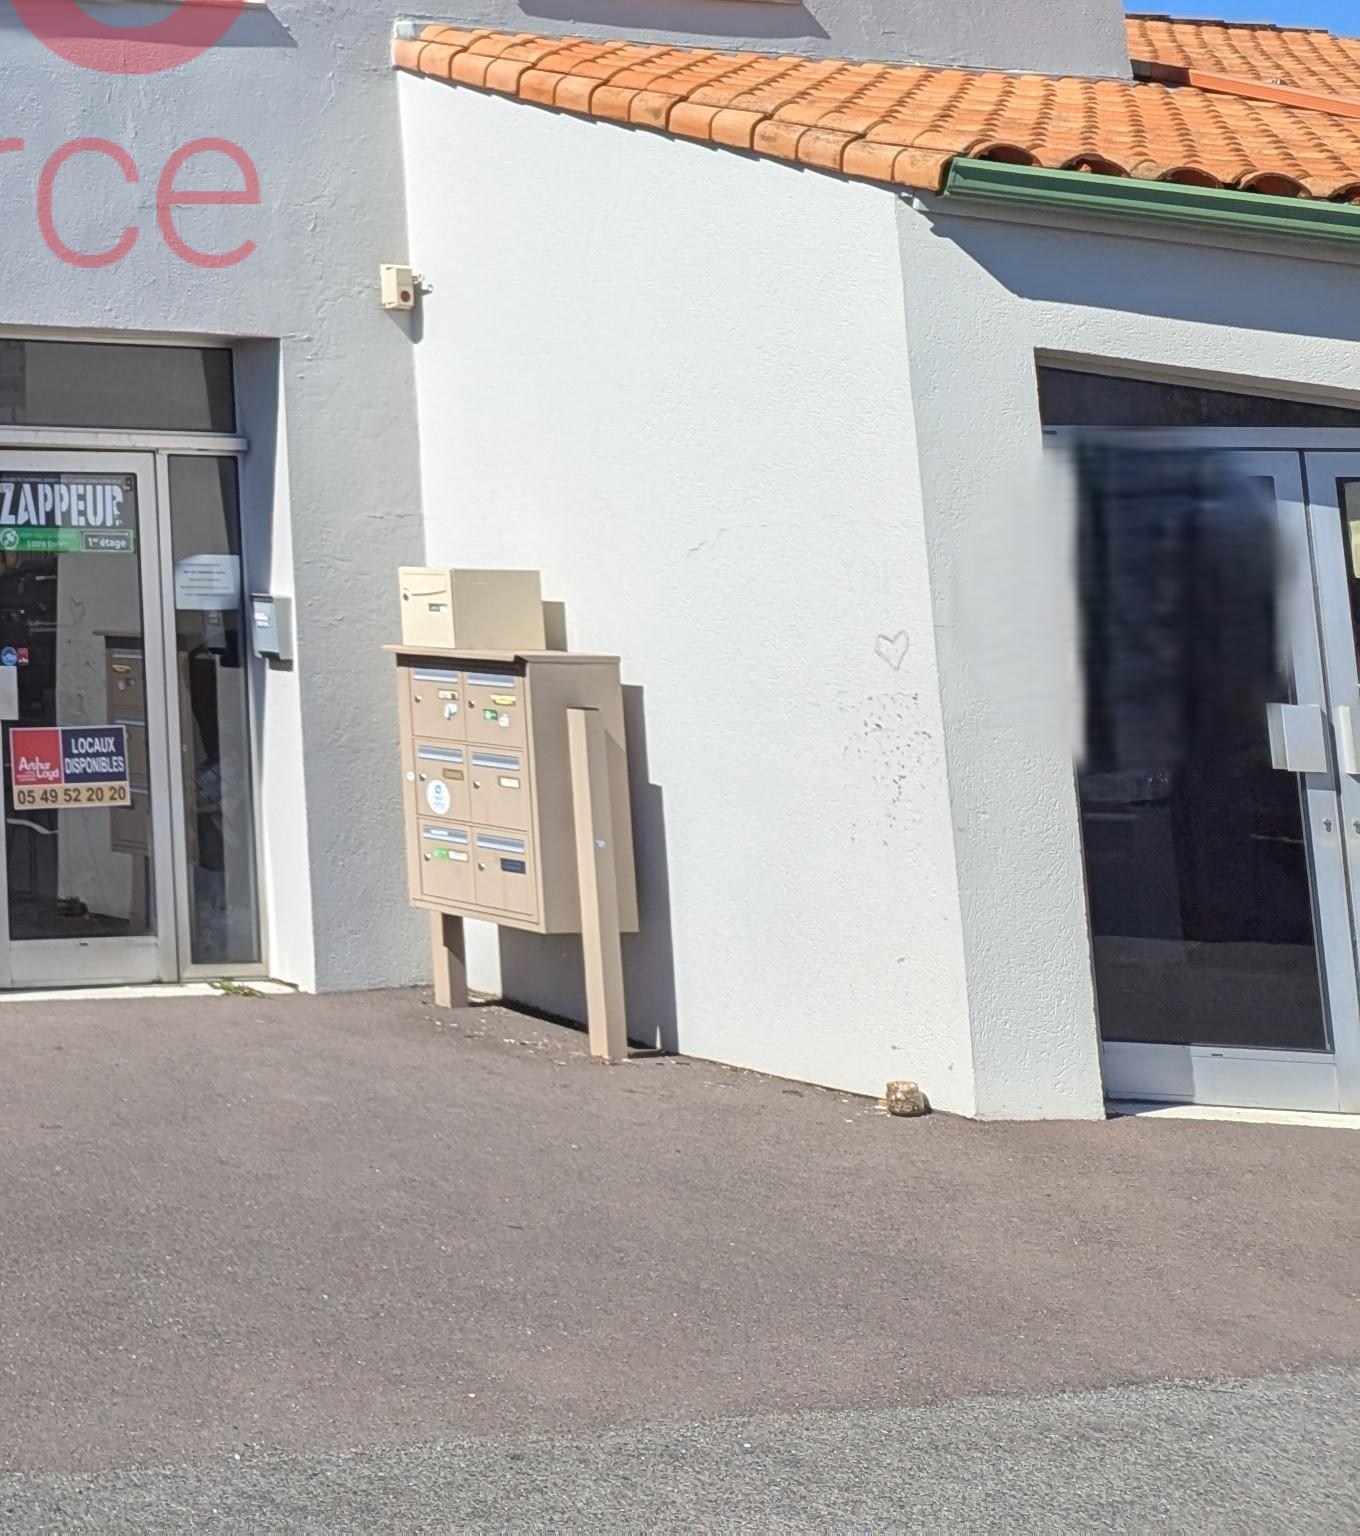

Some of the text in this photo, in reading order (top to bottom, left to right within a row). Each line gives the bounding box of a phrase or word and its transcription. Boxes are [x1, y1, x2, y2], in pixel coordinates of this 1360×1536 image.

[0, 482, 123, 527] ZAPPEUR
[100, 537, 127, 549] étage
[71, 737, 116, 754] LOCAUX
[19, 756, 51, 771] Arthur
[65, 756, 125, 774] DISPONIBLES
[17, 786, 126, 804] 05 49 52 20 20
